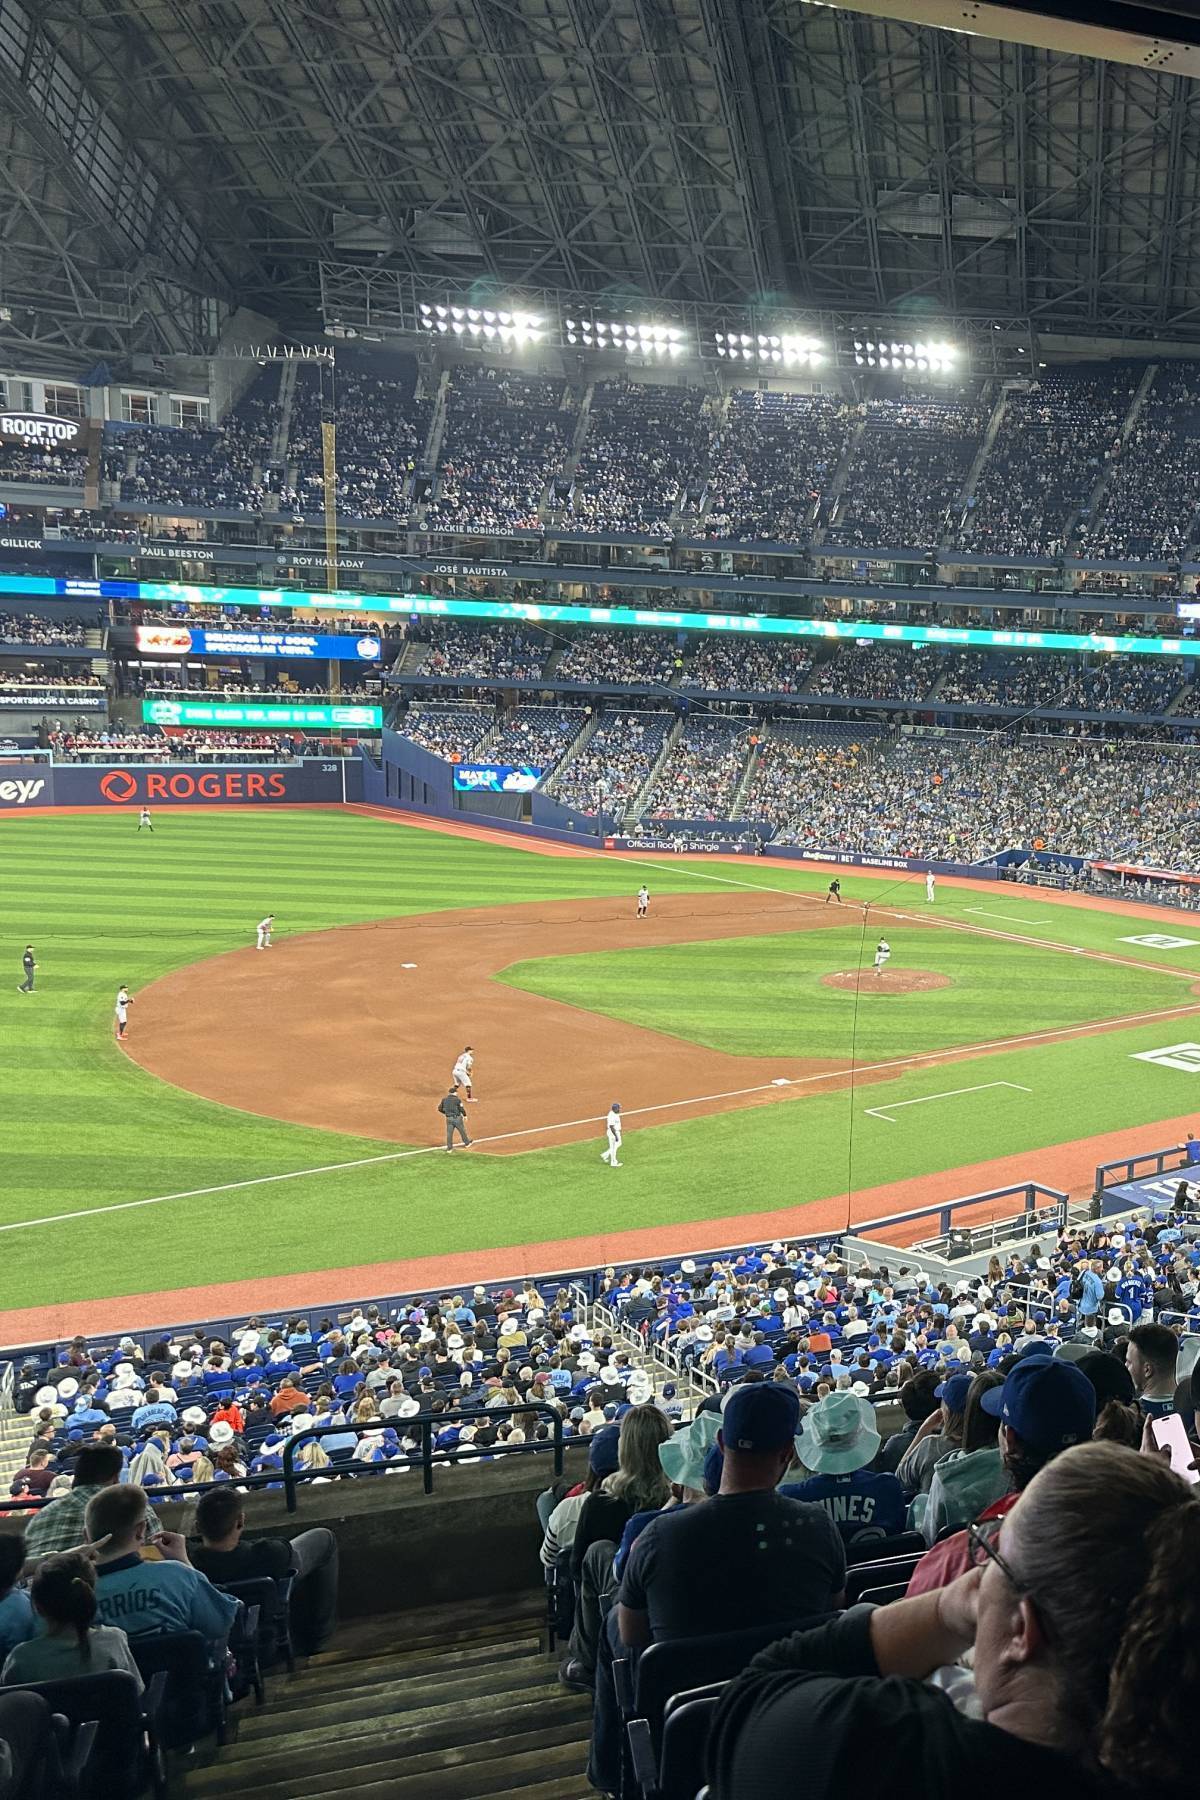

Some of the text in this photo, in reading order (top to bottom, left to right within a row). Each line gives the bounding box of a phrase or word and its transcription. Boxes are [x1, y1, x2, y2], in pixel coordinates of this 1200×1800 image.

[2, 418, 78, 440] ROOFTOP
[24, 436, 57, 447] PATIO
[433, 524, 464, 533] JACKIE
[467, 525, 514, 536] ROBINSON
[1, 538, 42, 549] GILLICK
[140, 547, 214, 560] PAUL BEESTON
[293, 556, 312, 566] ROY
[315, 558, 364, 569] HALLADAY
[434, 565, 508, 577] JOSÉ BAUTISTA
[0, 696, 57, 705] SPORTSBOOK
[67, 697, 99, 705] CASINO
[321, 764, 337, 773] 328
[0, 779, 45, 804] eys
[147, 773, 286, 799] ROGERS
[627, 839, 720, 852] Official Roog Shingle
[861, 857, 908, 869] BASELINE BOX
